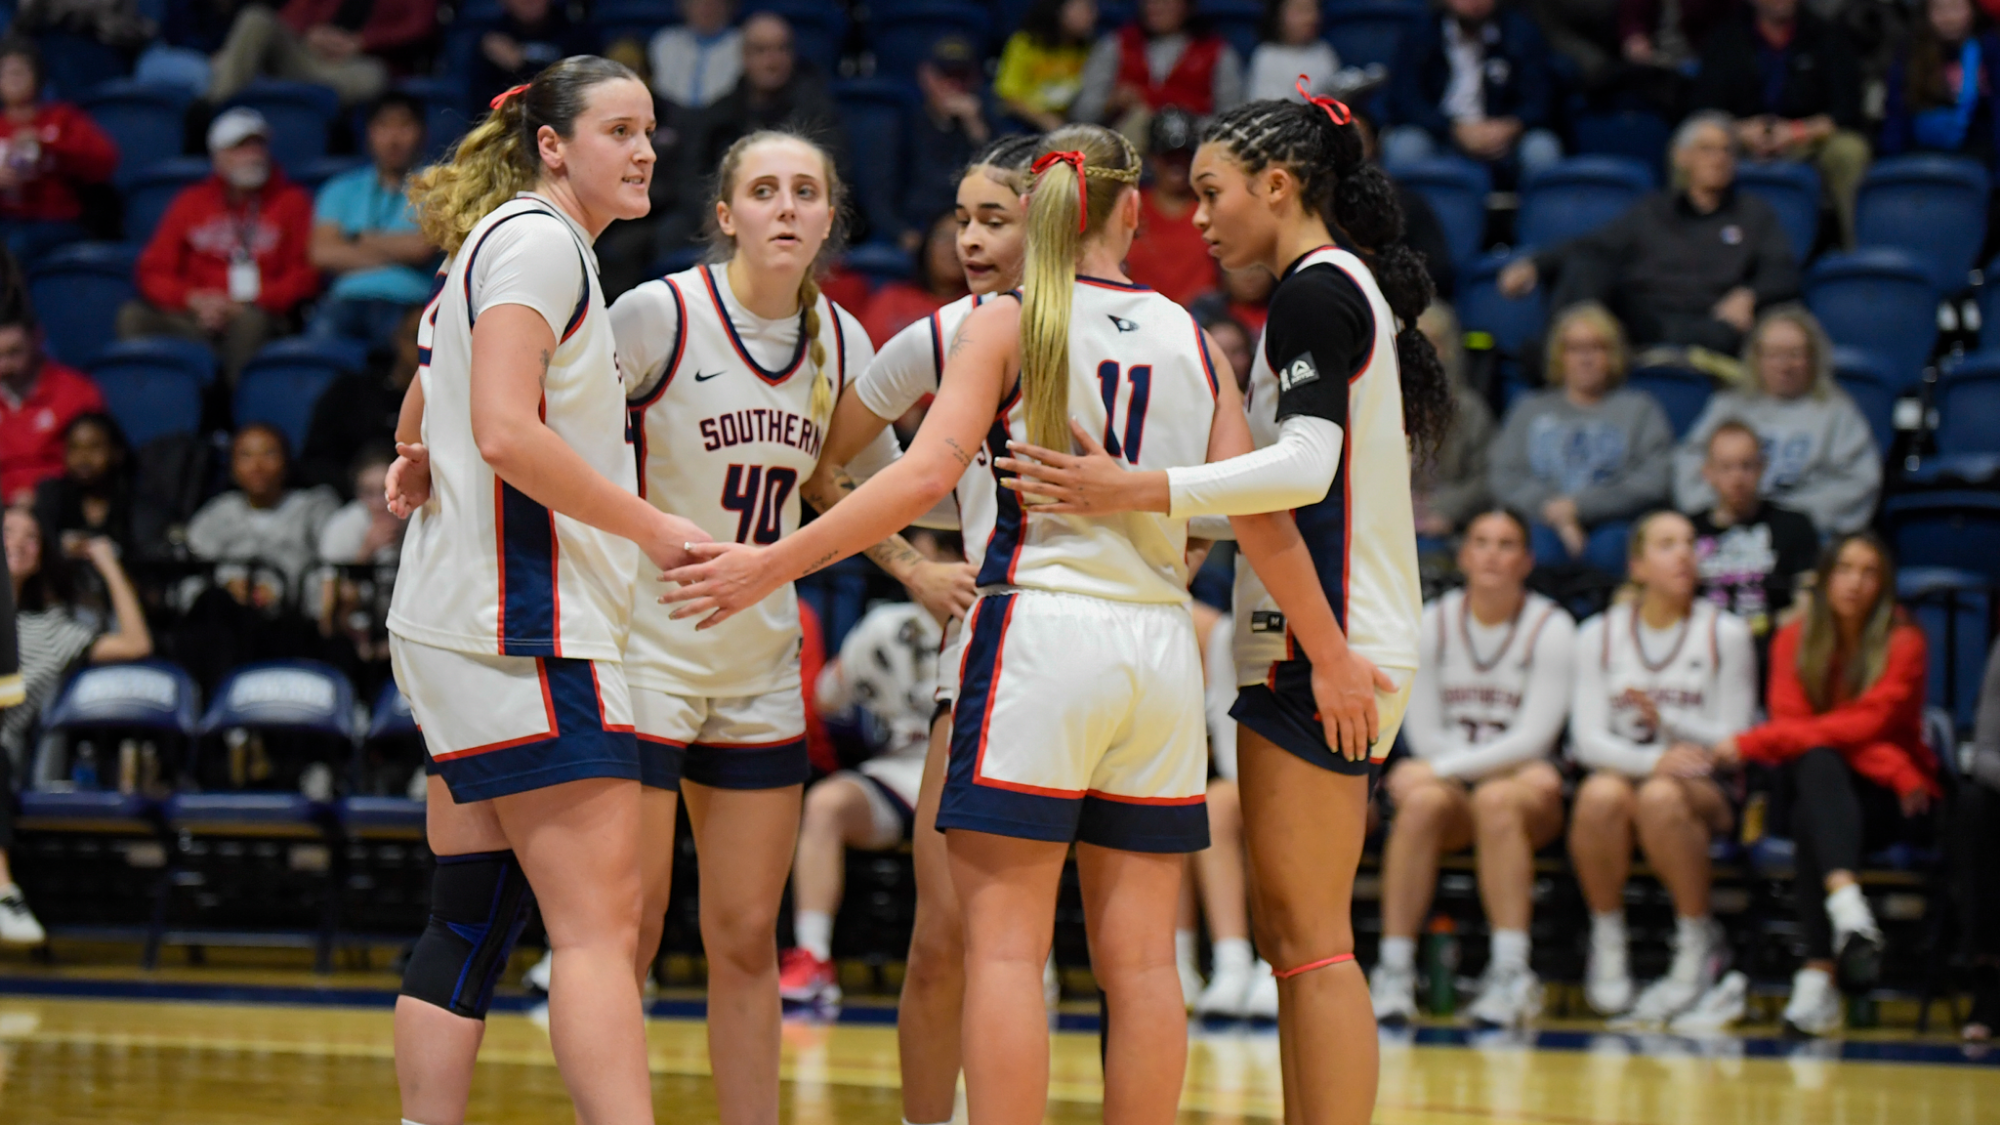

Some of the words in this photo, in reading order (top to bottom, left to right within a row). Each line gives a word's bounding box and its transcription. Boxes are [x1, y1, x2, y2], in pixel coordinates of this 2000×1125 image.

[699, 408, 821, 460] SOUTHERN
[1097, 359, 1152, 465] 11
[720, 463, 797, 545] 40
